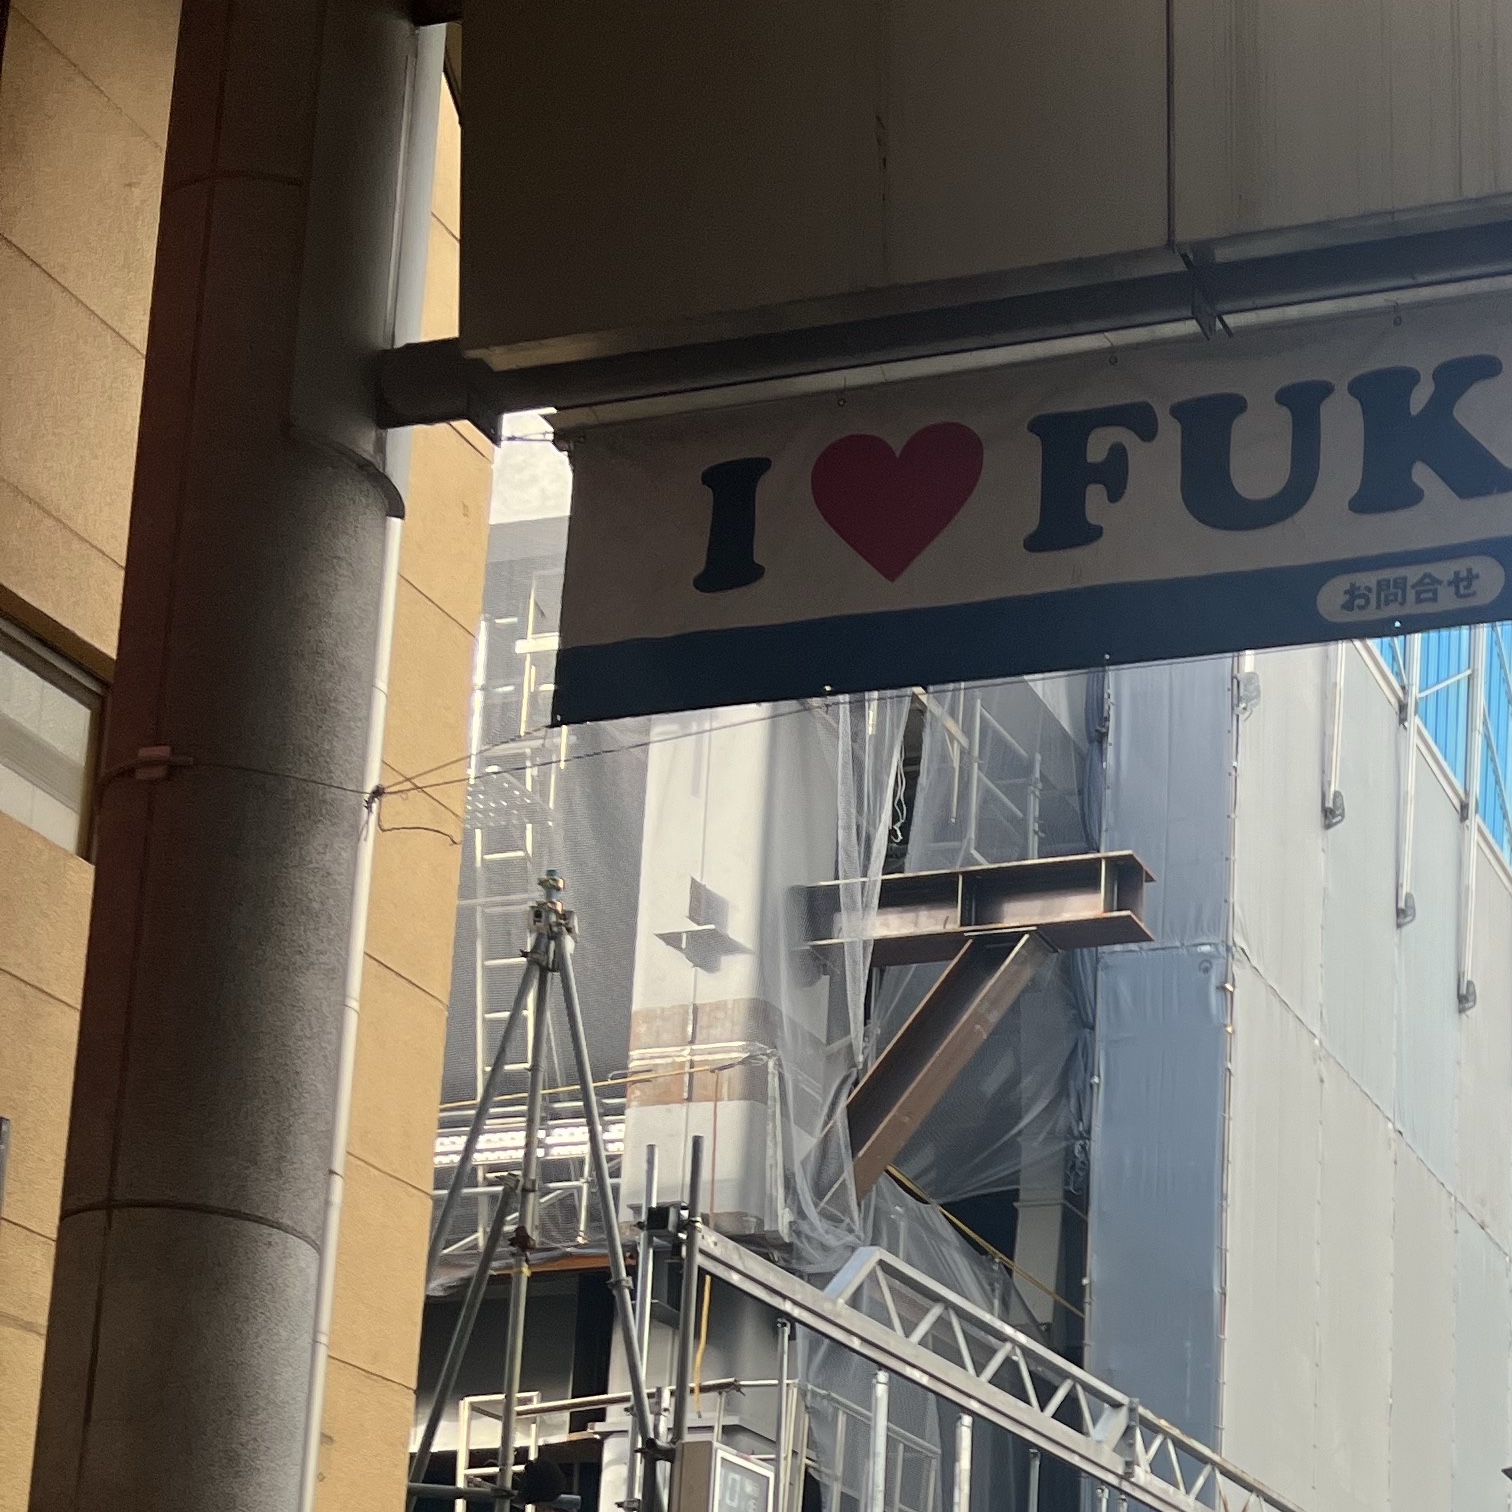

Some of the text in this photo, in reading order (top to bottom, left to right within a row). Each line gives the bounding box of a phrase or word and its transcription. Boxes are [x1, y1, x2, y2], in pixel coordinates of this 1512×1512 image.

[692, 456, 773, 595] I
[1340, 567, 1481, 612] お問合せ
